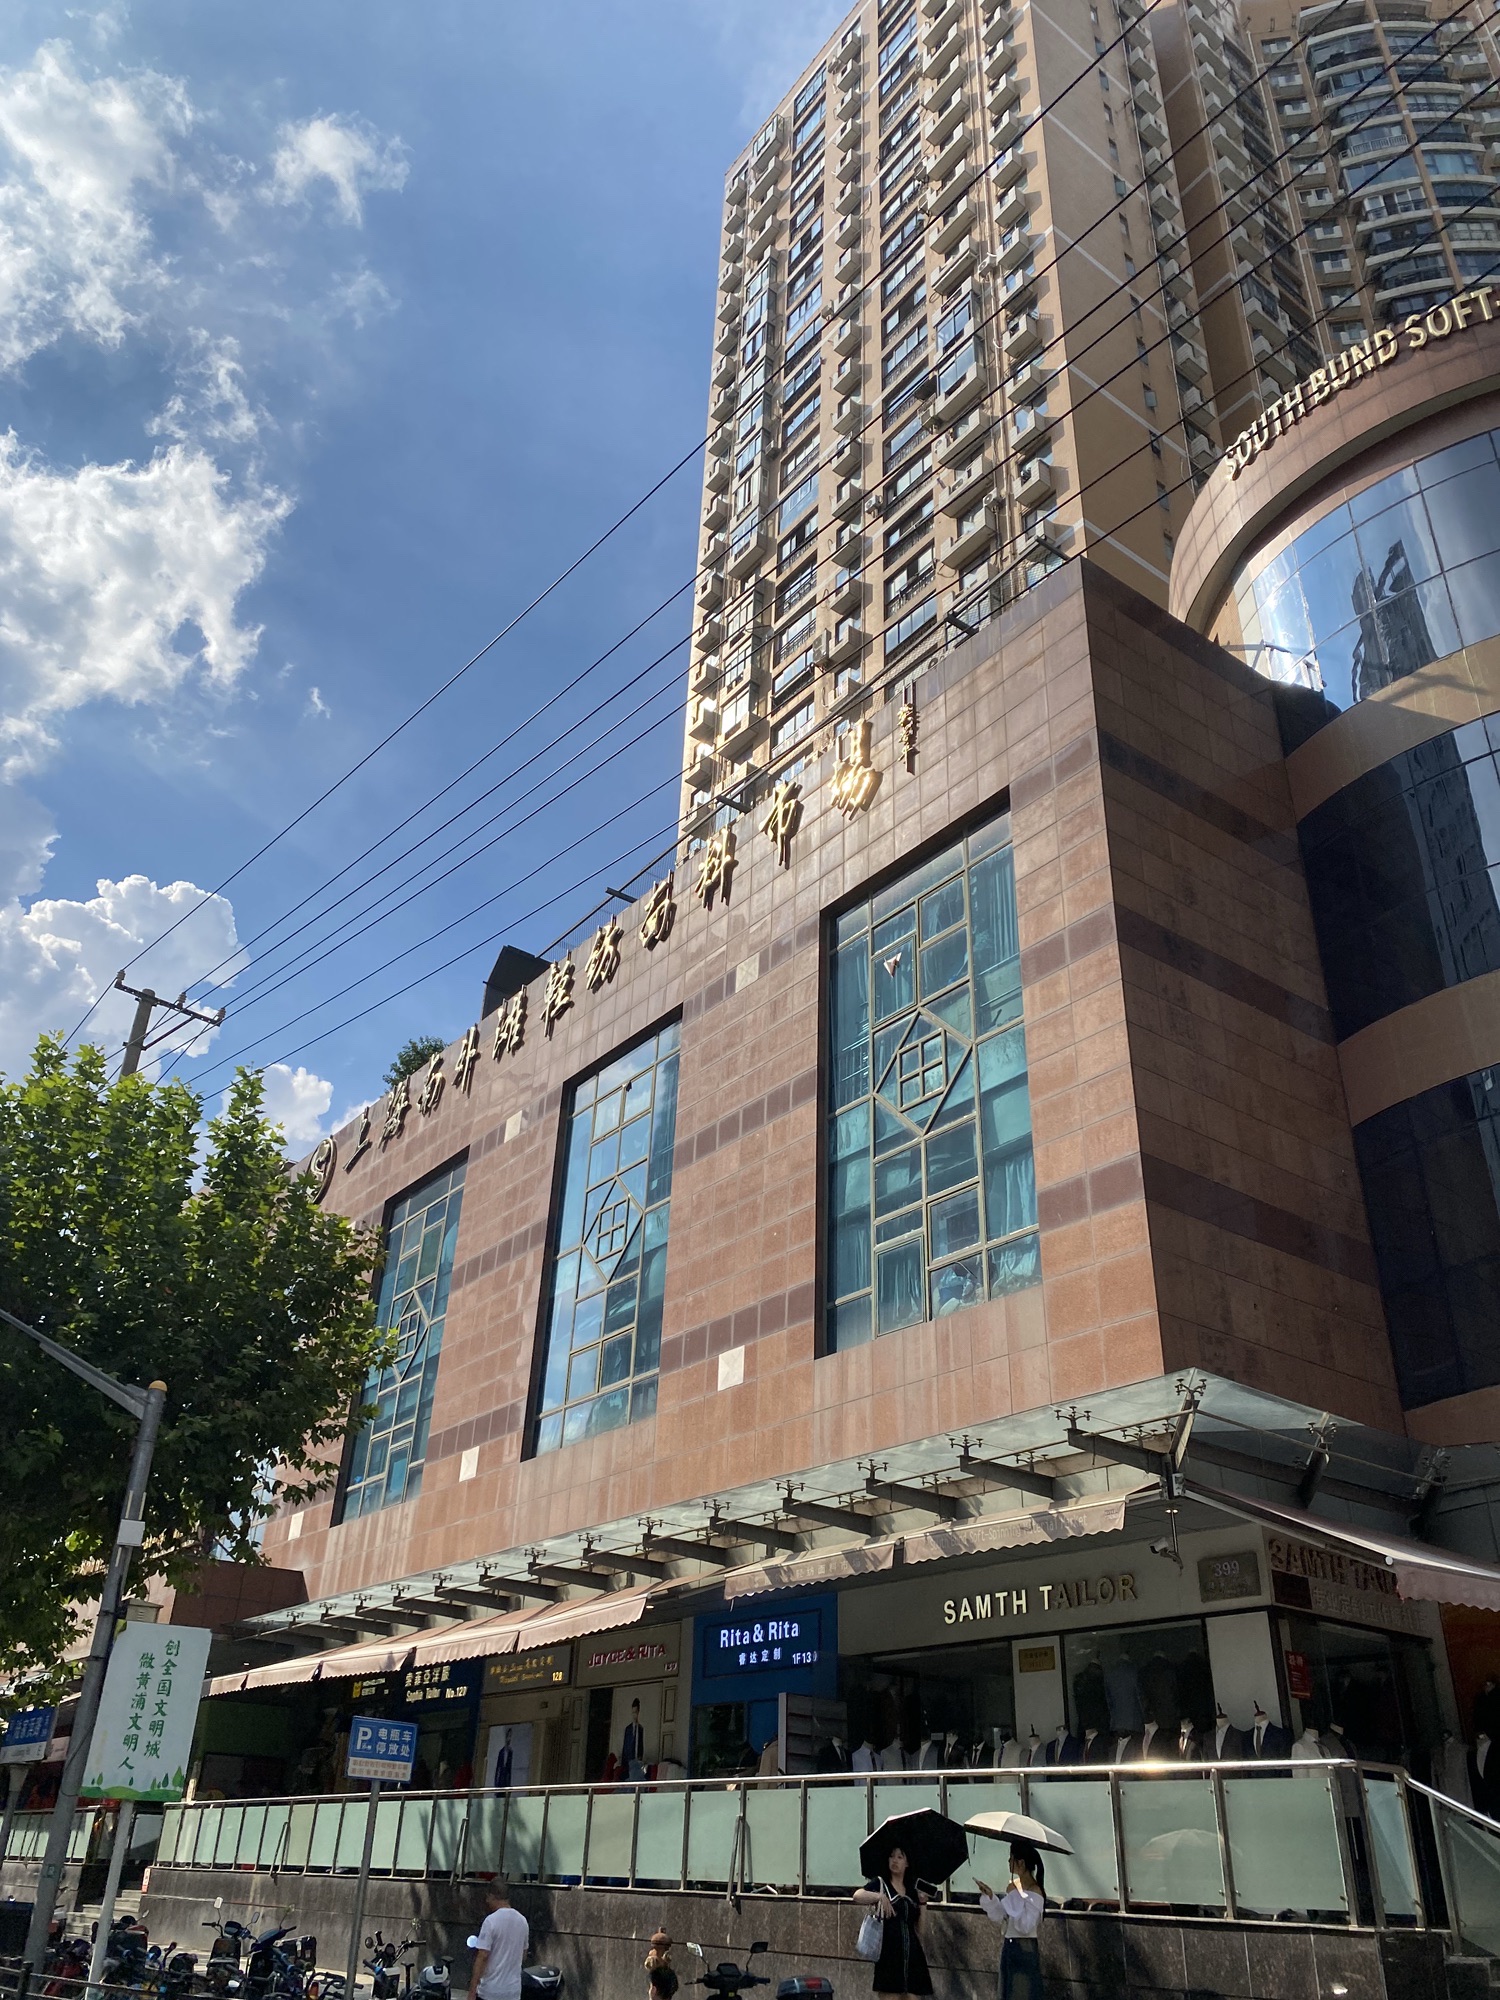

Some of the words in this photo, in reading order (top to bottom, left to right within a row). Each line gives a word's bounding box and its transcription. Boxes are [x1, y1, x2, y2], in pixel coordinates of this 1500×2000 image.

[1222, 383, 1307, 482] SOUTH
[1309, 329, 1399, 405] BUND
[1214, 1560, 1240, 1577] 399
[943, 1589, 1027, 1625] SAMTH
[1039, 1574, 1138, 1610] TAILOR
[720, 1628, 750, 1648] Rita
[768, 1621, 799, 1641] Rita
[118, 1652, 156, 1770] 做黄浦文明人
[143, 1639, 181, 1759] 创全国文明城
[376, 1742, 410, 1757] 停放处
[378, 1728, 413, 1743] 电瓶车
